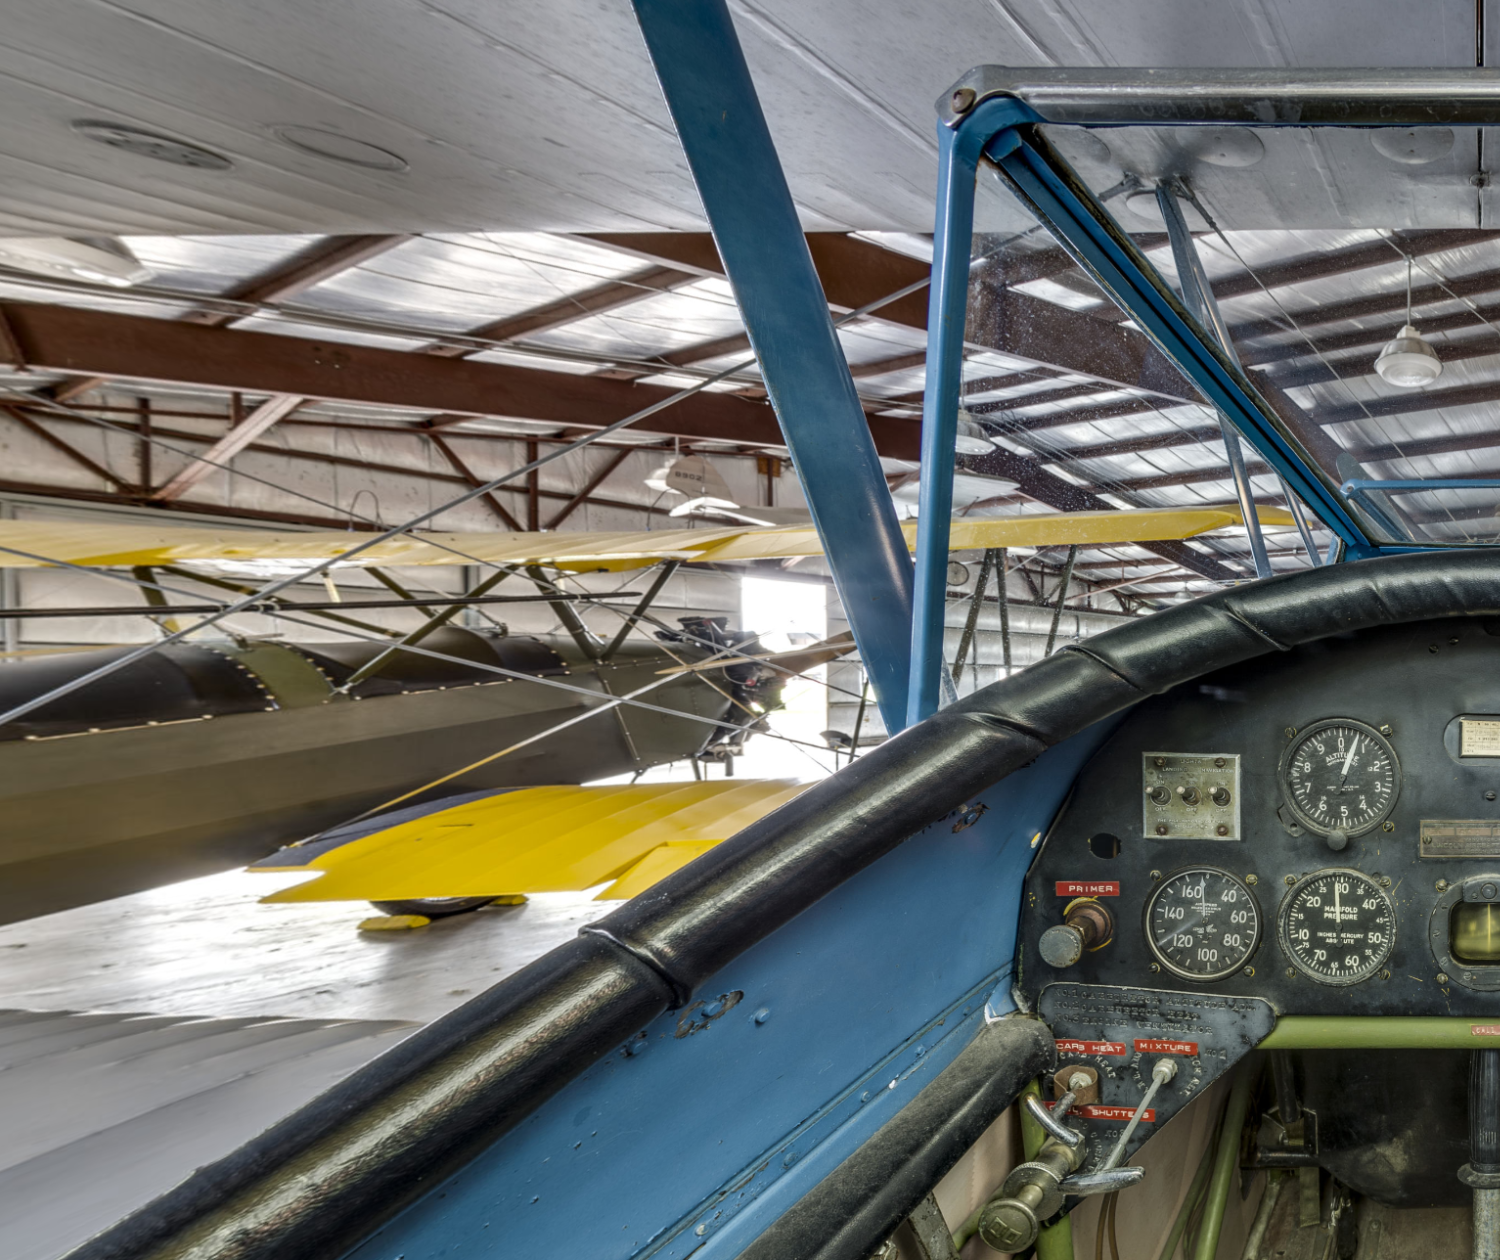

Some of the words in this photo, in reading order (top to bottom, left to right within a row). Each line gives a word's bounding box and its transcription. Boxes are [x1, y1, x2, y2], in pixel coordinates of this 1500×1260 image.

[1337, 737, 1345, 748] 0
[1361, 743, 1365, 753] 1
[1317, 743, 1325, 754] 9
[1325, 751, 1360, 763] ALTITUE
[1304, 762, 1311, 773] 8
[1373, 761, 1380, 772] 2
[1304, 782, 1312, 793] 7
[1374, 781, 1381, 793] 3
[1319, 800, 1327, 811] 6
[1359, 800, 1367, 810] 4
[1340, 805, 1348, 817] 5
[1068, 885, 1113, 893] PRIMER
[1182, 885, 1202, 898] 160
[1221, 889, 1237, 902] 40
[1306, 896, 1321, 907] 20
[1362, 899, 1376, 910] 40
[1164, 906, 1184, 920] 140
[1230, 910, 1247, 923] 60
[1173, 933, 1193, 947] 120
[1223, 933, 1240, 946] 80
[1299, 929, 1309, 940] 10
[1367, 932, 1381, 943] 50
[1197, 948, 1218, 961] 100
[1313, 949, 1327, 960] 70
[1345, 955, 1359, 966] 60
[1056, 1043, 1085, 1051] CARB
[1092, 1045, 1122, 1053] HEAT
[1140, 1043, 1191, 1052] MIXTURE
[1092, 1108, 1149, 1118] SHUTTES
